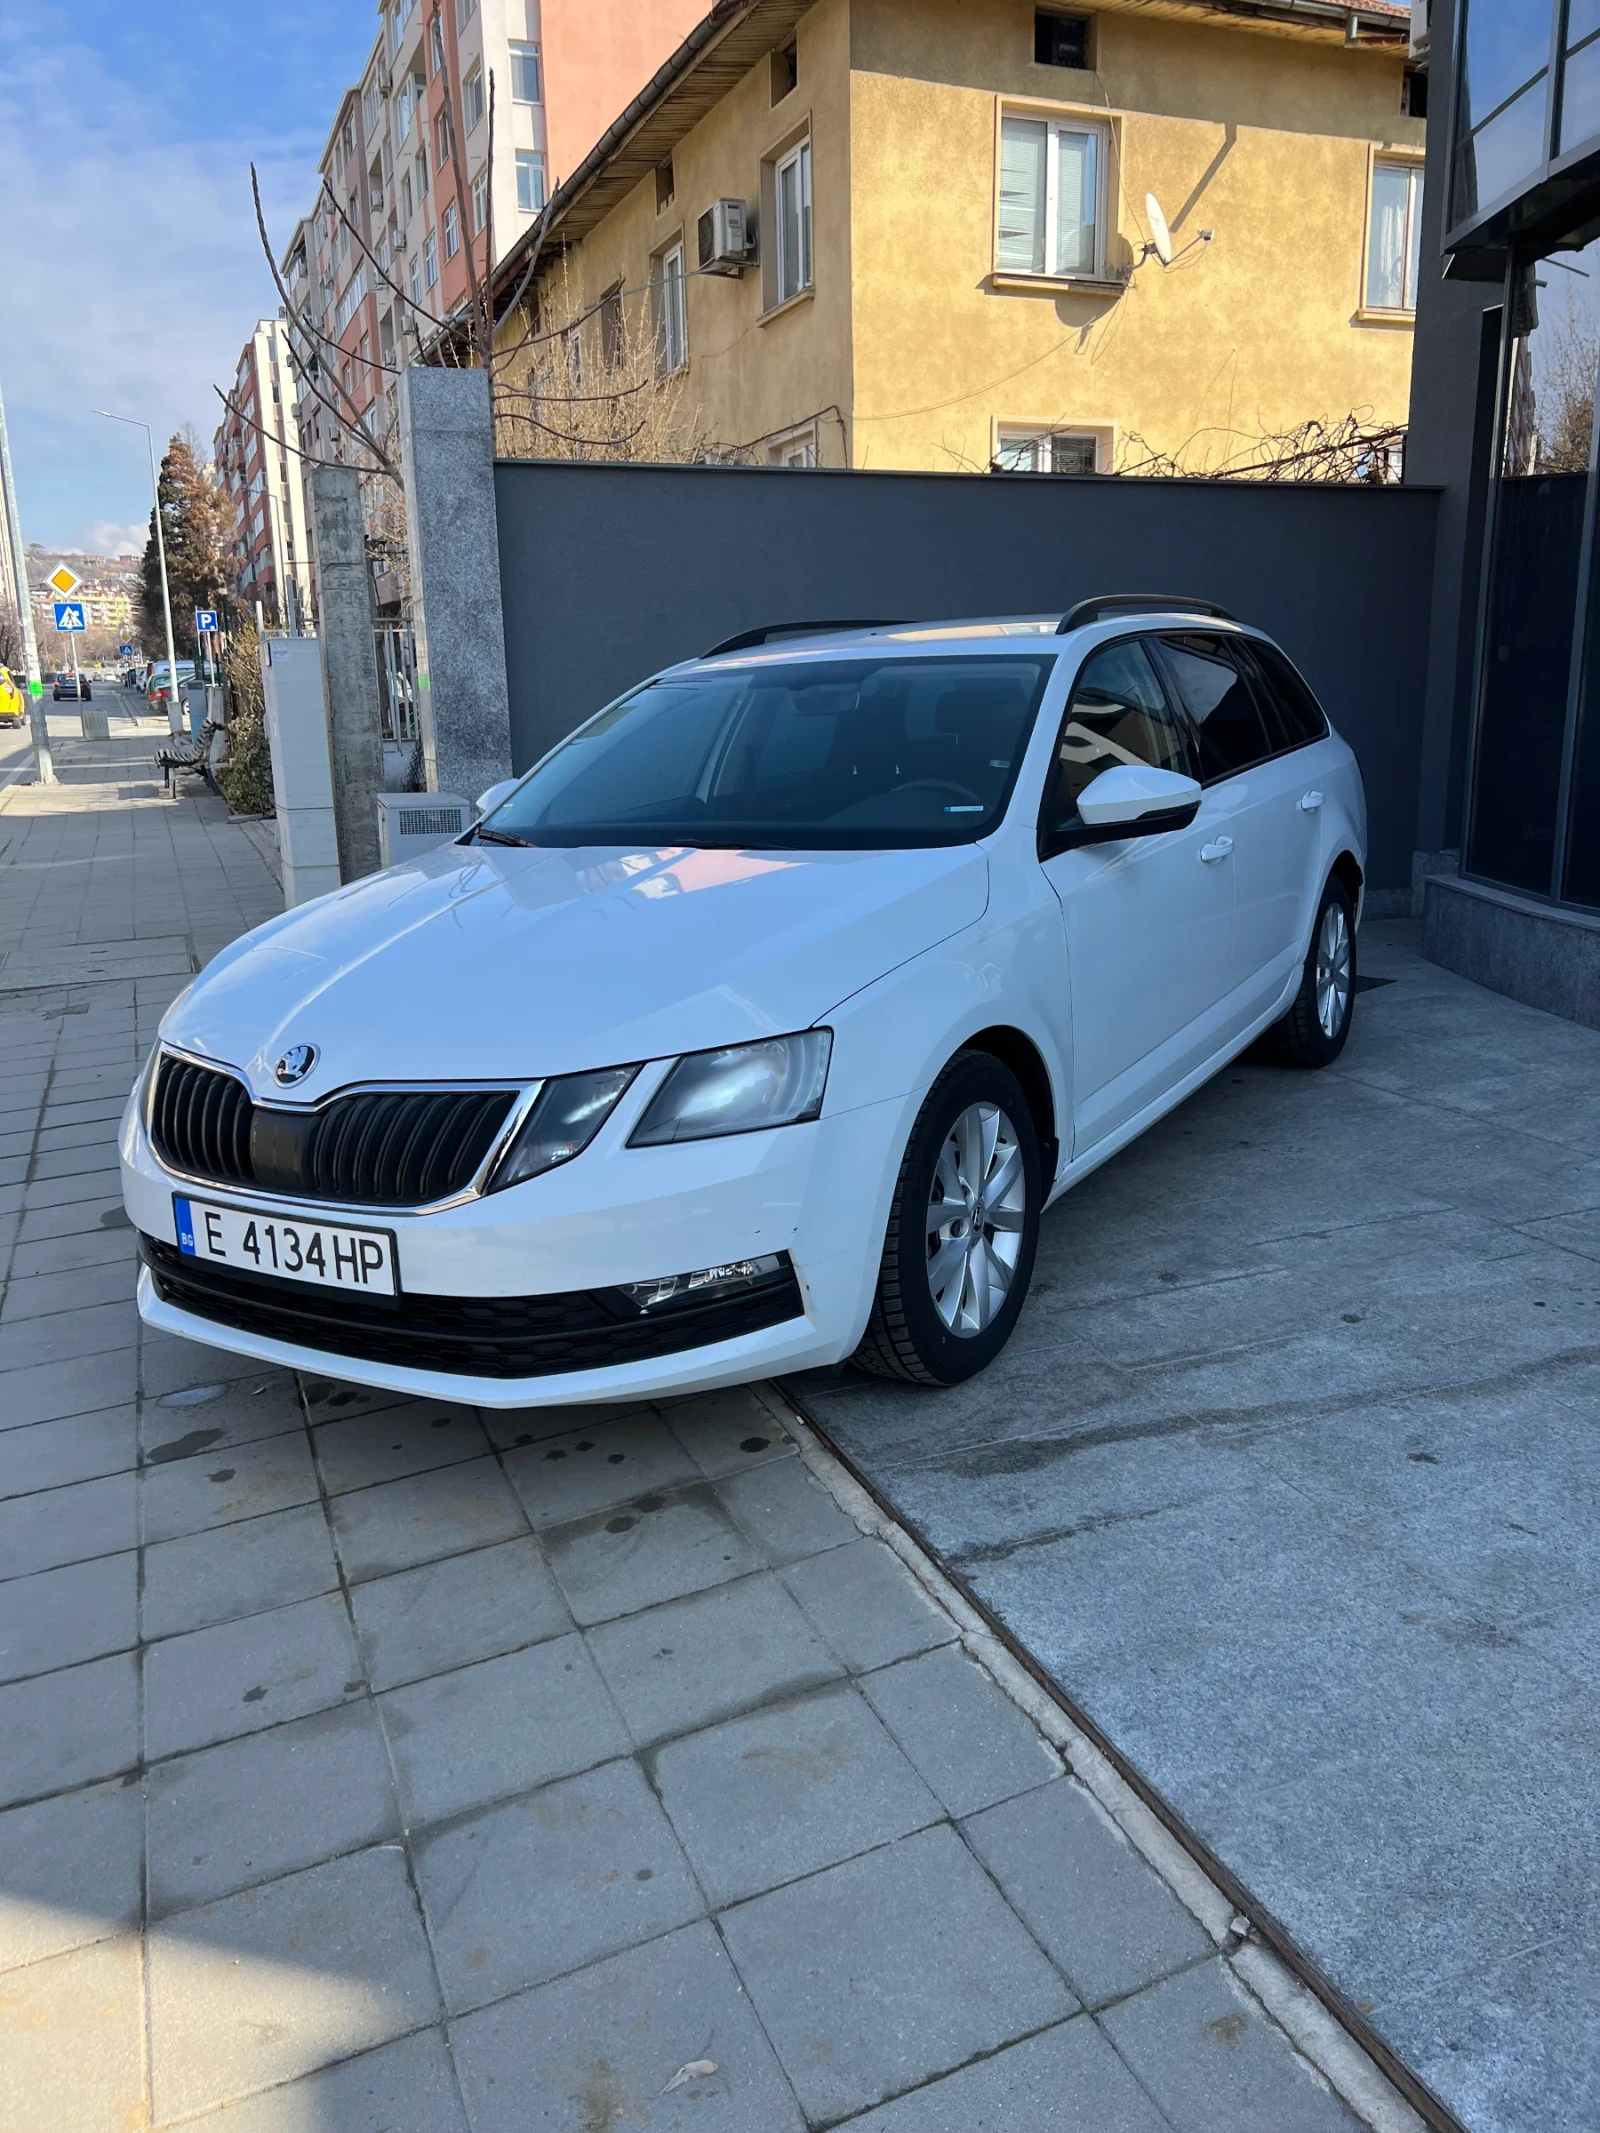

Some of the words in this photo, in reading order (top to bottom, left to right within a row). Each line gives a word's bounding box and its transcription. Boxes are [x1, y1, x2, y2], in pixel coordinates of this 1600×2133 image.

[201, 613, 212, 629] P
[181, 1232, 194, 1247] BG
[204, 1211, 227, 1257] E
